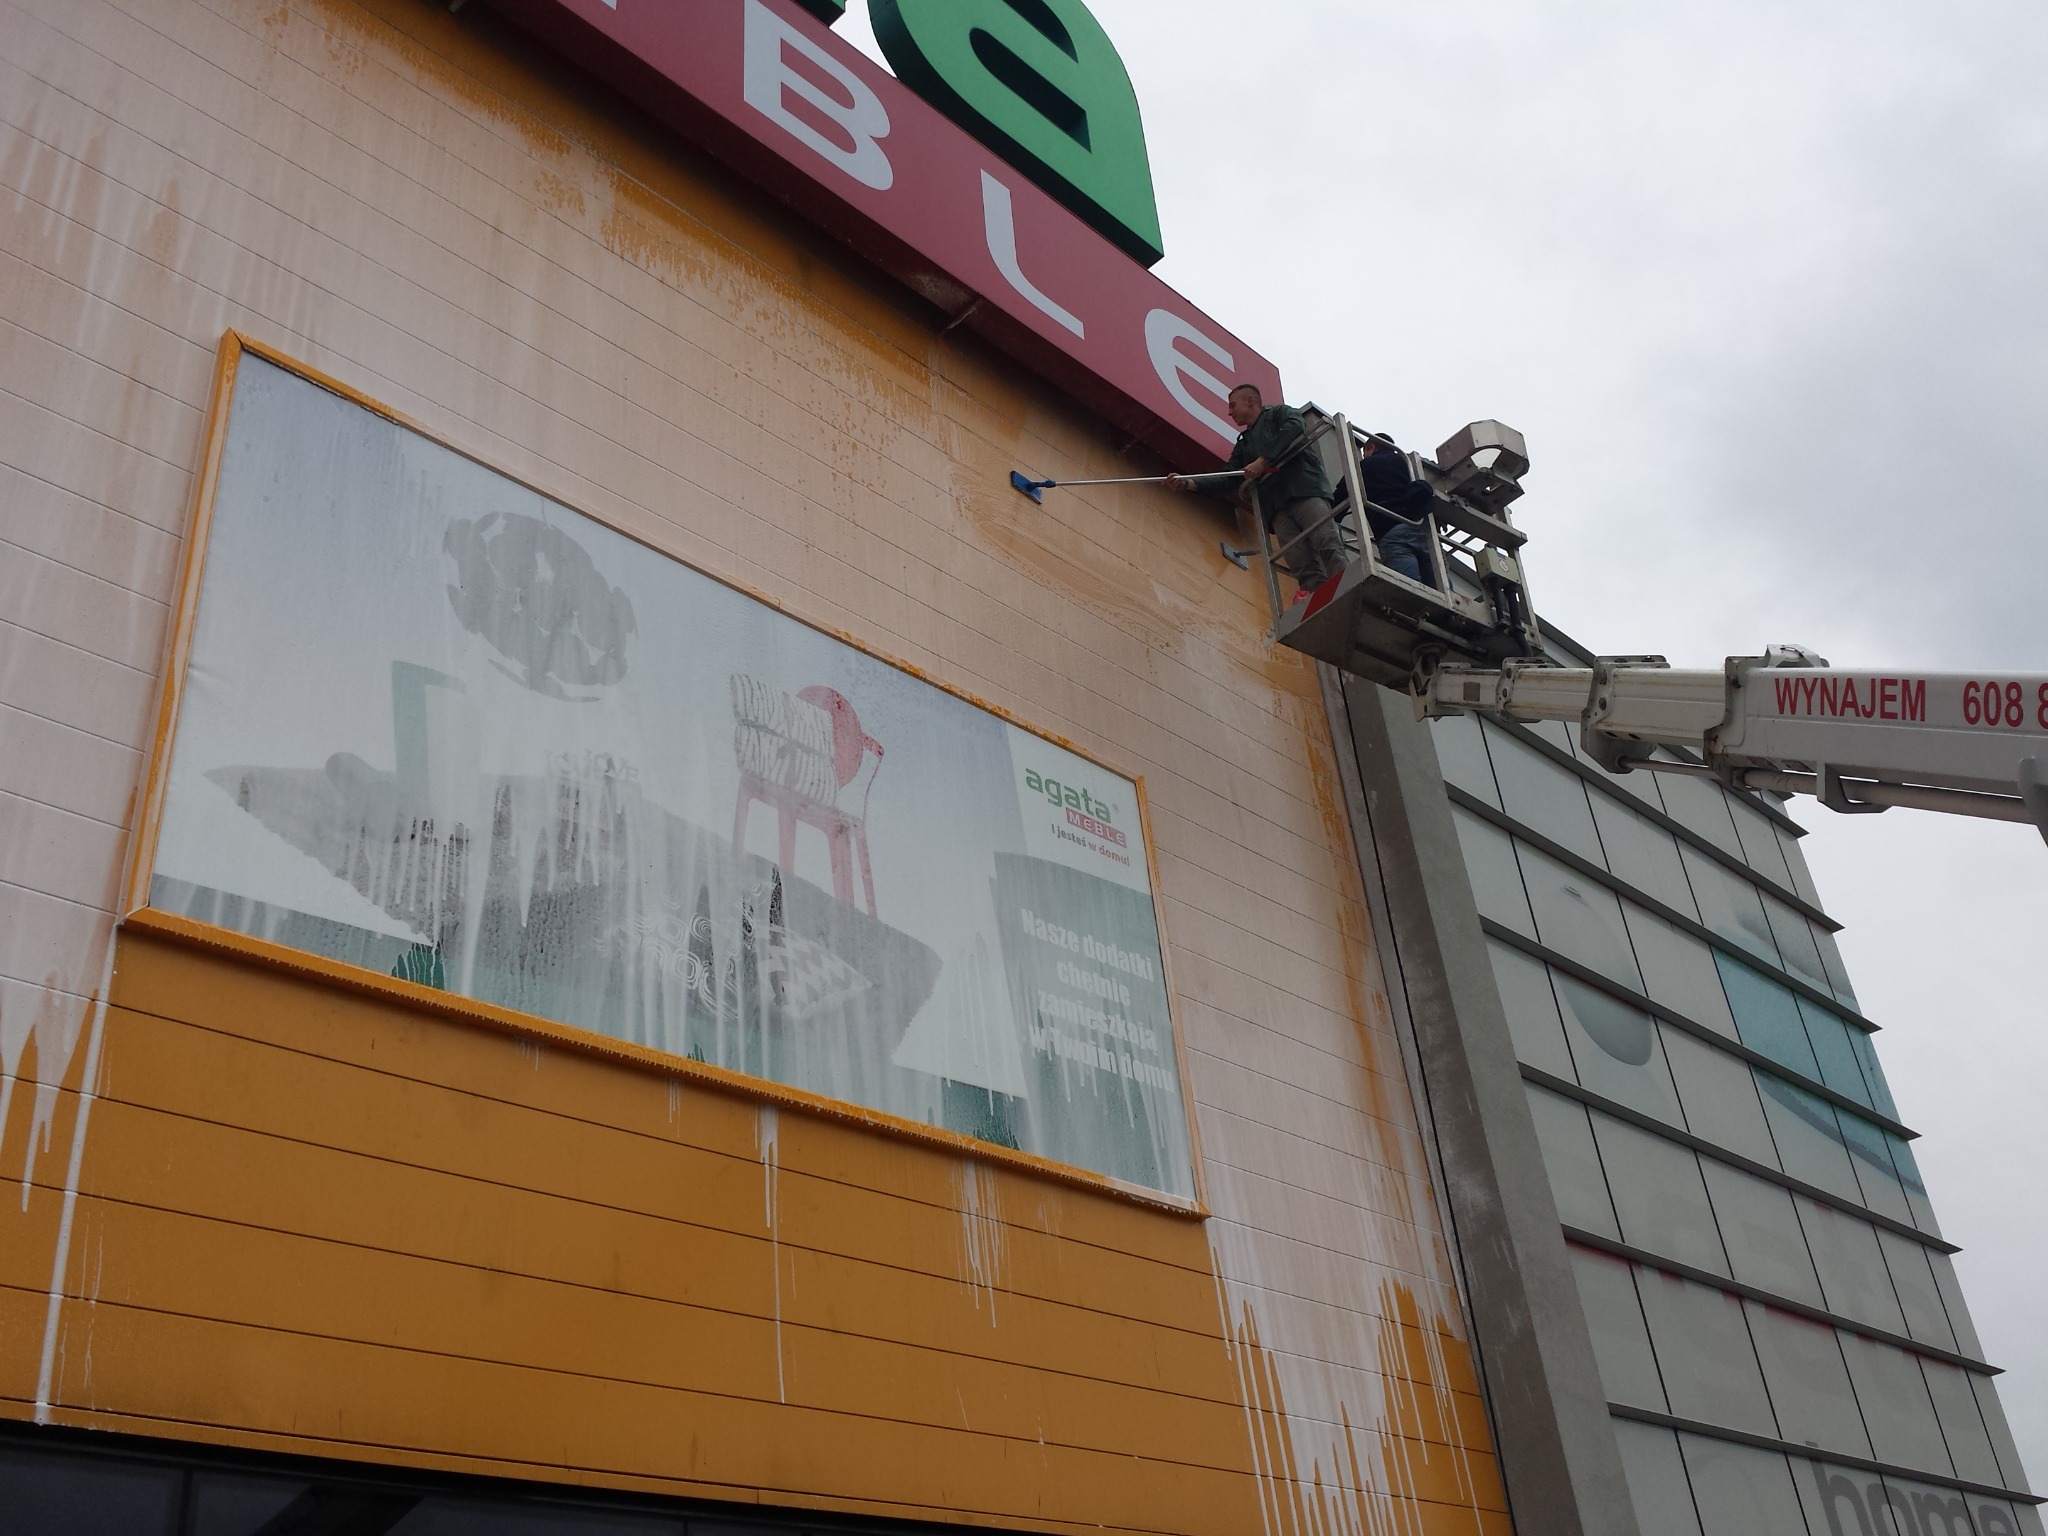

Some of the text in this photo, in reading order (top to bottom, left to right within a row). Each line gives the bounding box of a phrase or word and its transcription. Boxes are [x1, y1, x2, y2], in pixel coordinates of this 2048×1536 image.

[599, 0, 1239, 444] BLE
[1775, 677, 1926, 721] WYNAJEM
[1963, 680, 2023, 727] 608
[1025, 768, 1111, 823] agata
[1068, 810, 1126, 846] MEBLE
[1088, 841, 1097, 852] w
[1021, 907, 1154, 982] Nasze dodatki
[1056, 960, 1131, 1007] chętnie
[1050, 1026, 1118, 1075] Twoim
[1119, 1051, 1175, 1093] domu
